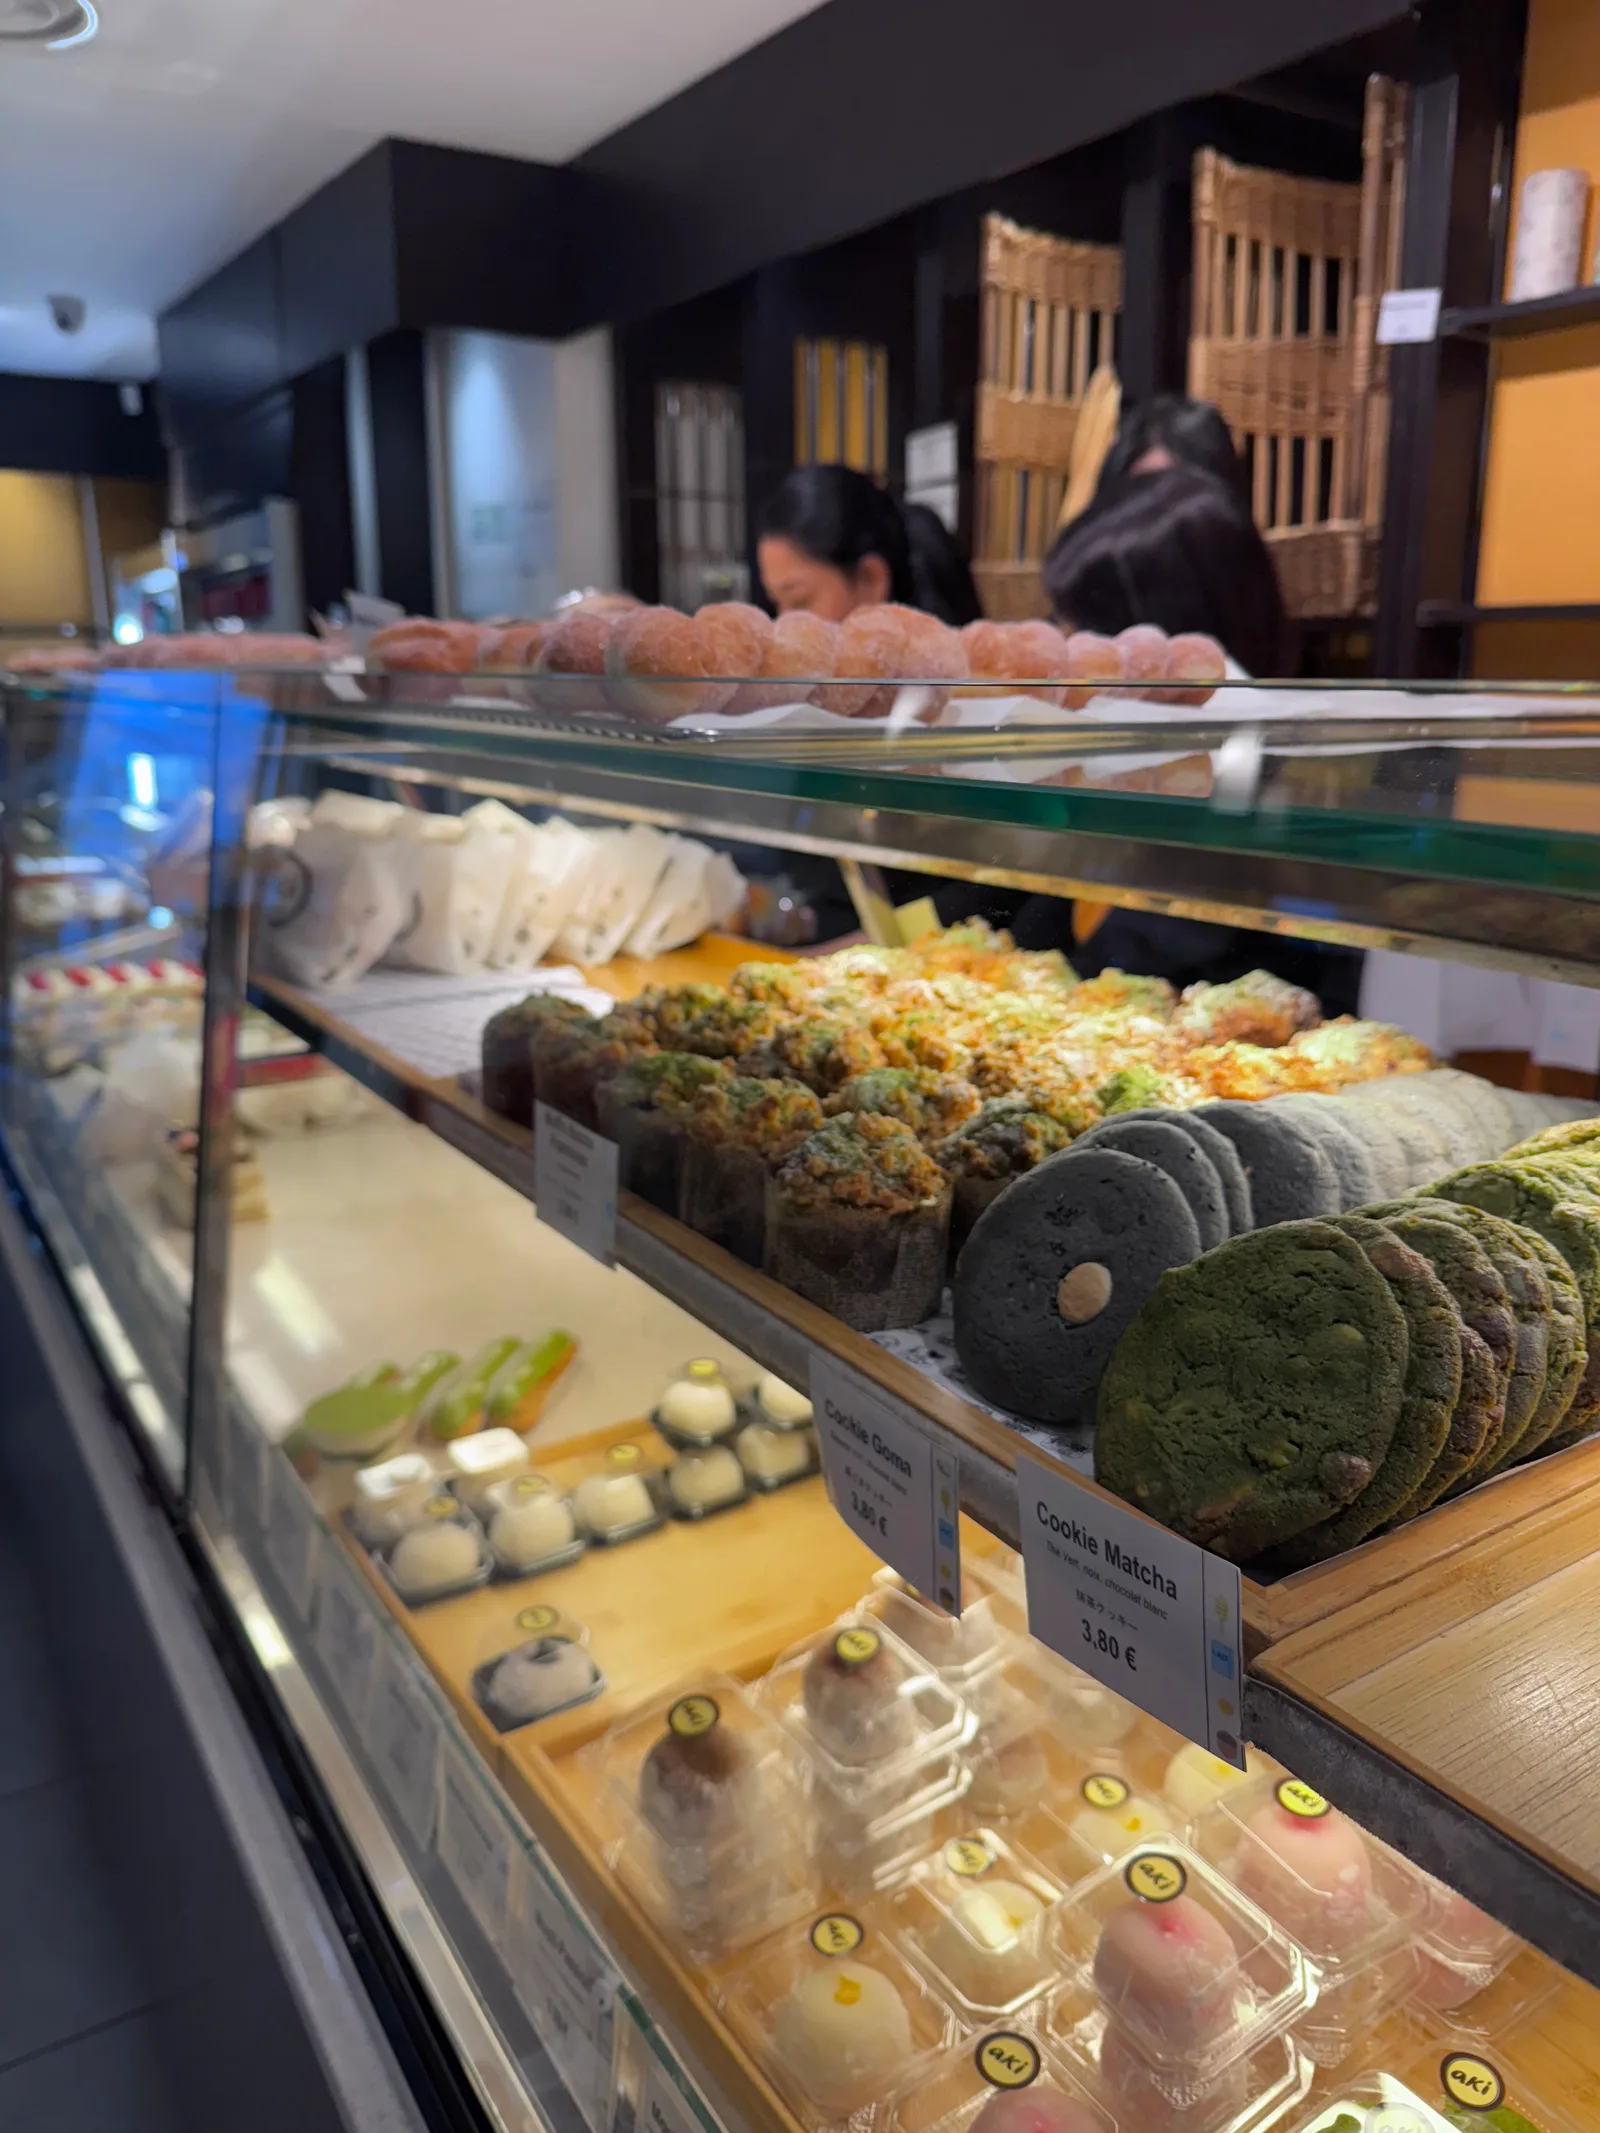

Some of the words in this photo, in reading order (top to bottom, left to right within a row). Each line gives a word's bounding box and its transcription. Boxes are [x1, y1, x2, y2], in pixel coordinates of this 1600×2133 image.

[824, 1398, 868, 1445] Cookie
[871, 1433, 912, 1478] Goma
[1036, 1500, 1098, 1555] Cookie
[1104, 1538, 1178, 1601] Matcha
[1104, 1578, 1141, 1606] chocolat
[1143, 1597, 1168, 1620] blanc
[1125, 1646, 1137, 1672] €
[988, 2047, 1028, 2075] aki
[1450, 2069, 1493, 2096] aki
